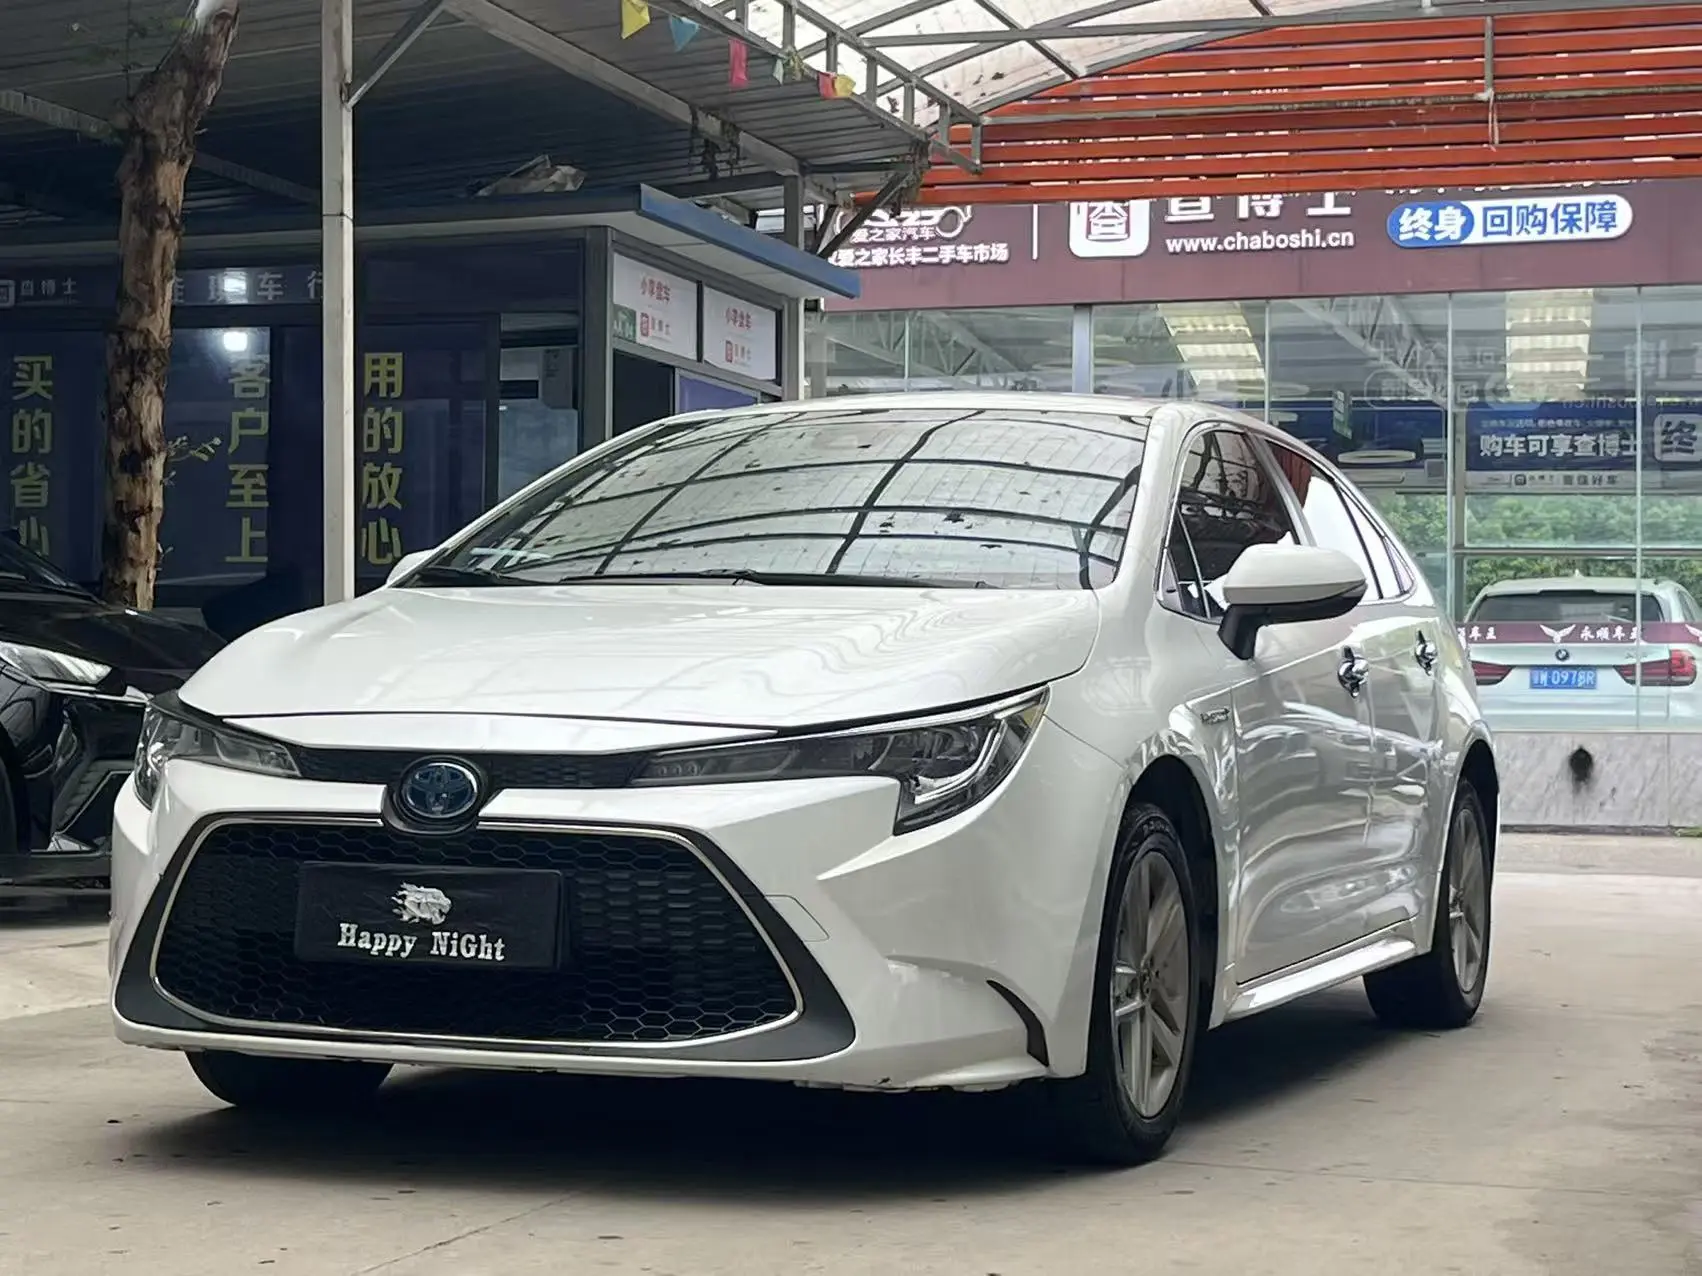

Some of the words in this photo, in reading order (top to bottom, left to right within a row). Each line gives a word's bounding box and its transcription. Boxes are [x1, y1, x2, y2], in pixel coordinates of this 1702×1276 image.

[1165, 229, 1355, 253] www.chaboshi.cn
[1399, 206, 1466, 241] 终身
[1482, 200, 1617, 237] 回购保障
[11, 355, 53, 557] 买的省心
[225, 353, 270, 564] 客户至上
[362, 352, 403, 565] 用的放心
[337, 922, 417, 958] Happy
[430, 931, 506, 961] NiGht
